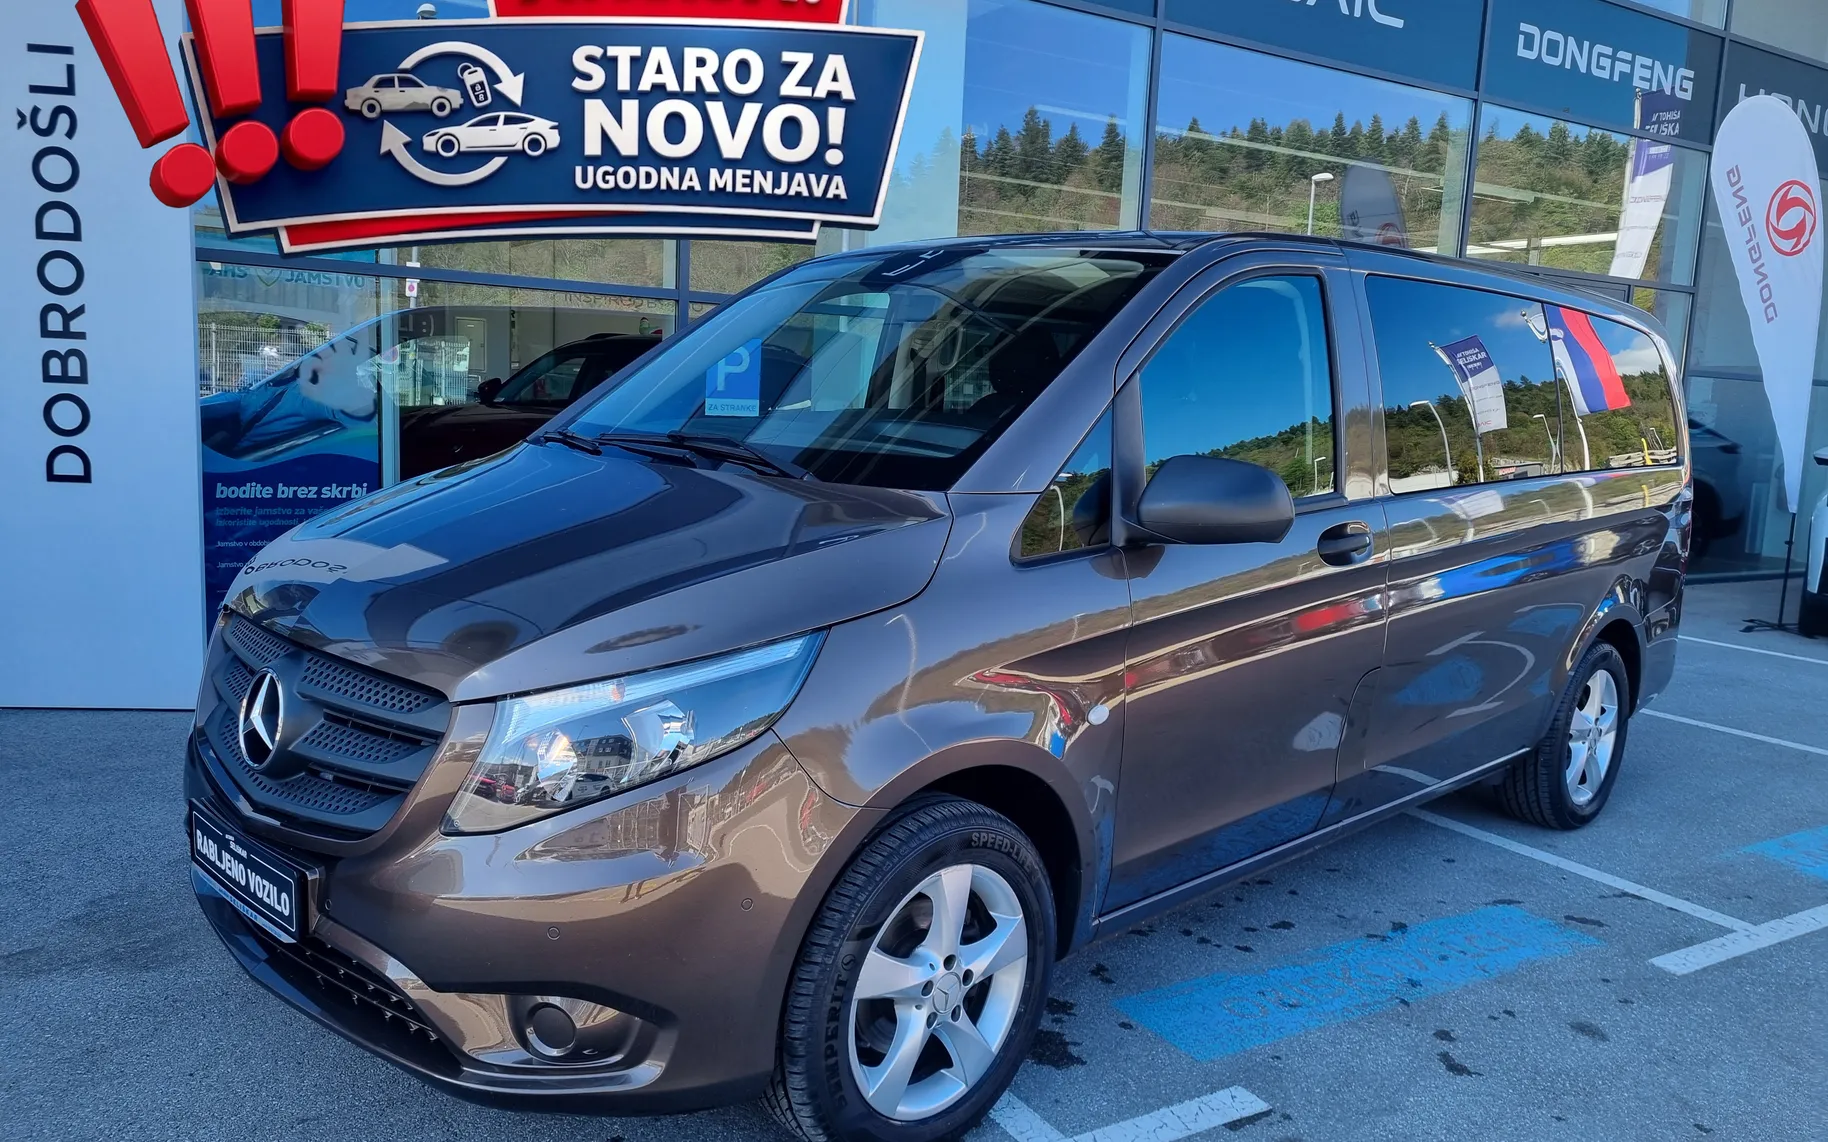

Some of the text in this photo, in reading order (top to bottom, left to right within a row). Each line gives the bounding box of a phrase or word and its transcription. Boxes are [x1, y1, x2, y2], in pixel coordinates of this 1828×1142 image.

[1517, 22, 1694, 100] DONGFENG
[16, 43, 93, 484] DOBRODOŠLI
[708, 403, 757, 412] ZA STRANKE
[717, 346, 750, 391] P
[216, 482, 368, 499] bodite brez skrbi
[196, 829, 290, 917] RABLJENO VOZILO
[824, 974, 849, 1110] SEMPERIT
